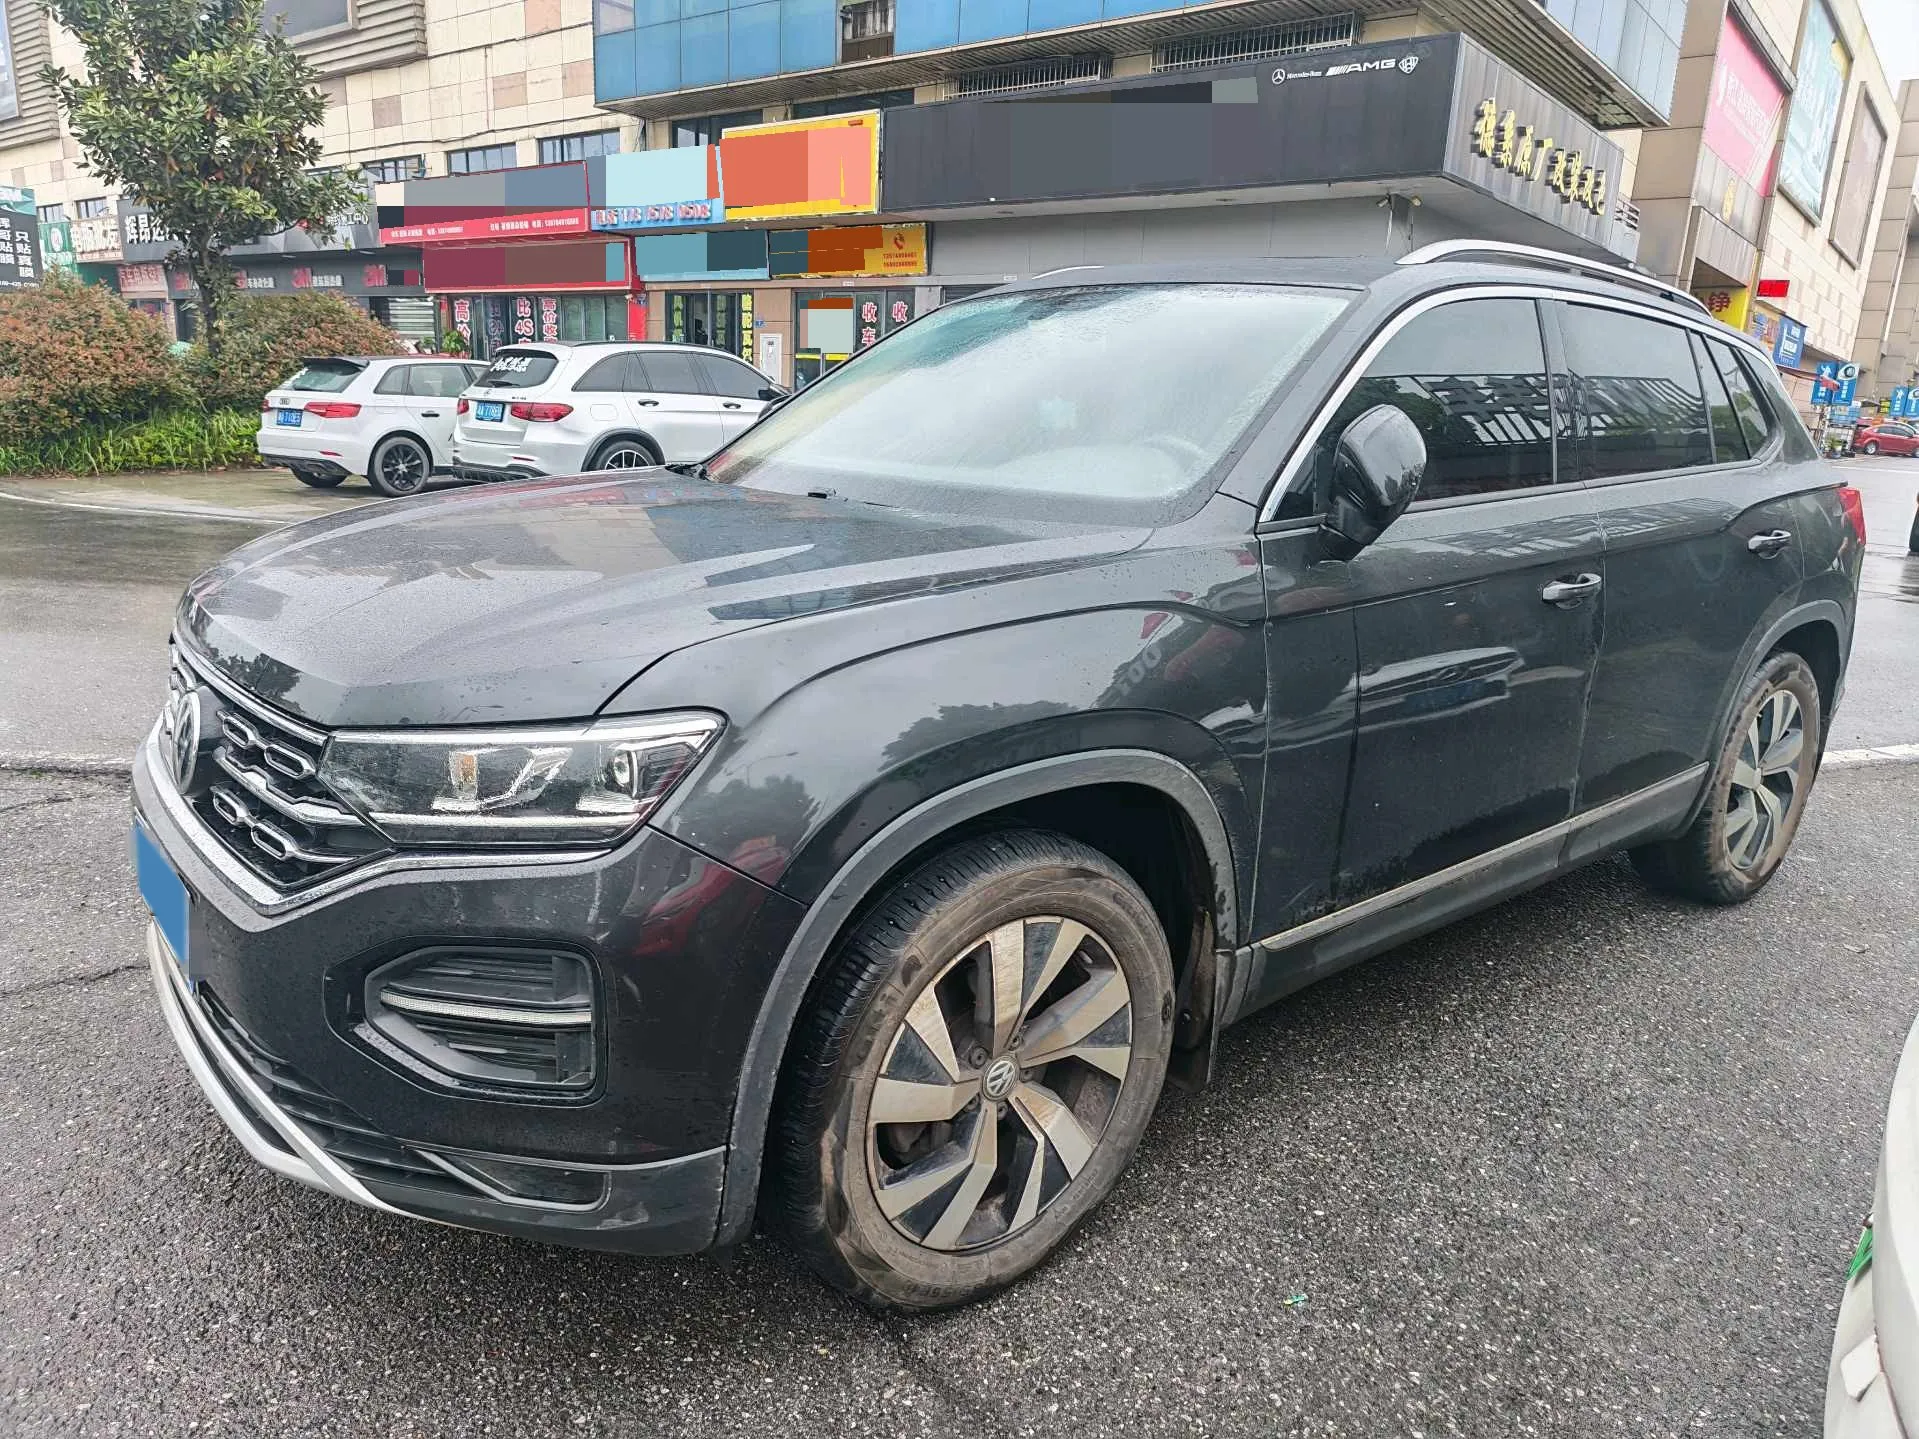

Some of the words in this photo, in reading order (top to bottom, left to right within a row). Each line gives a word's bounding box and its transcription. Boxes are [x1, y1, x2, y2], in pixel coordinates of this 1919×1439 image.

[1347, 58, 1396, 73] AMG
[892, 301, 908, 322] 收
[862, 302, 877, 347] 收车
